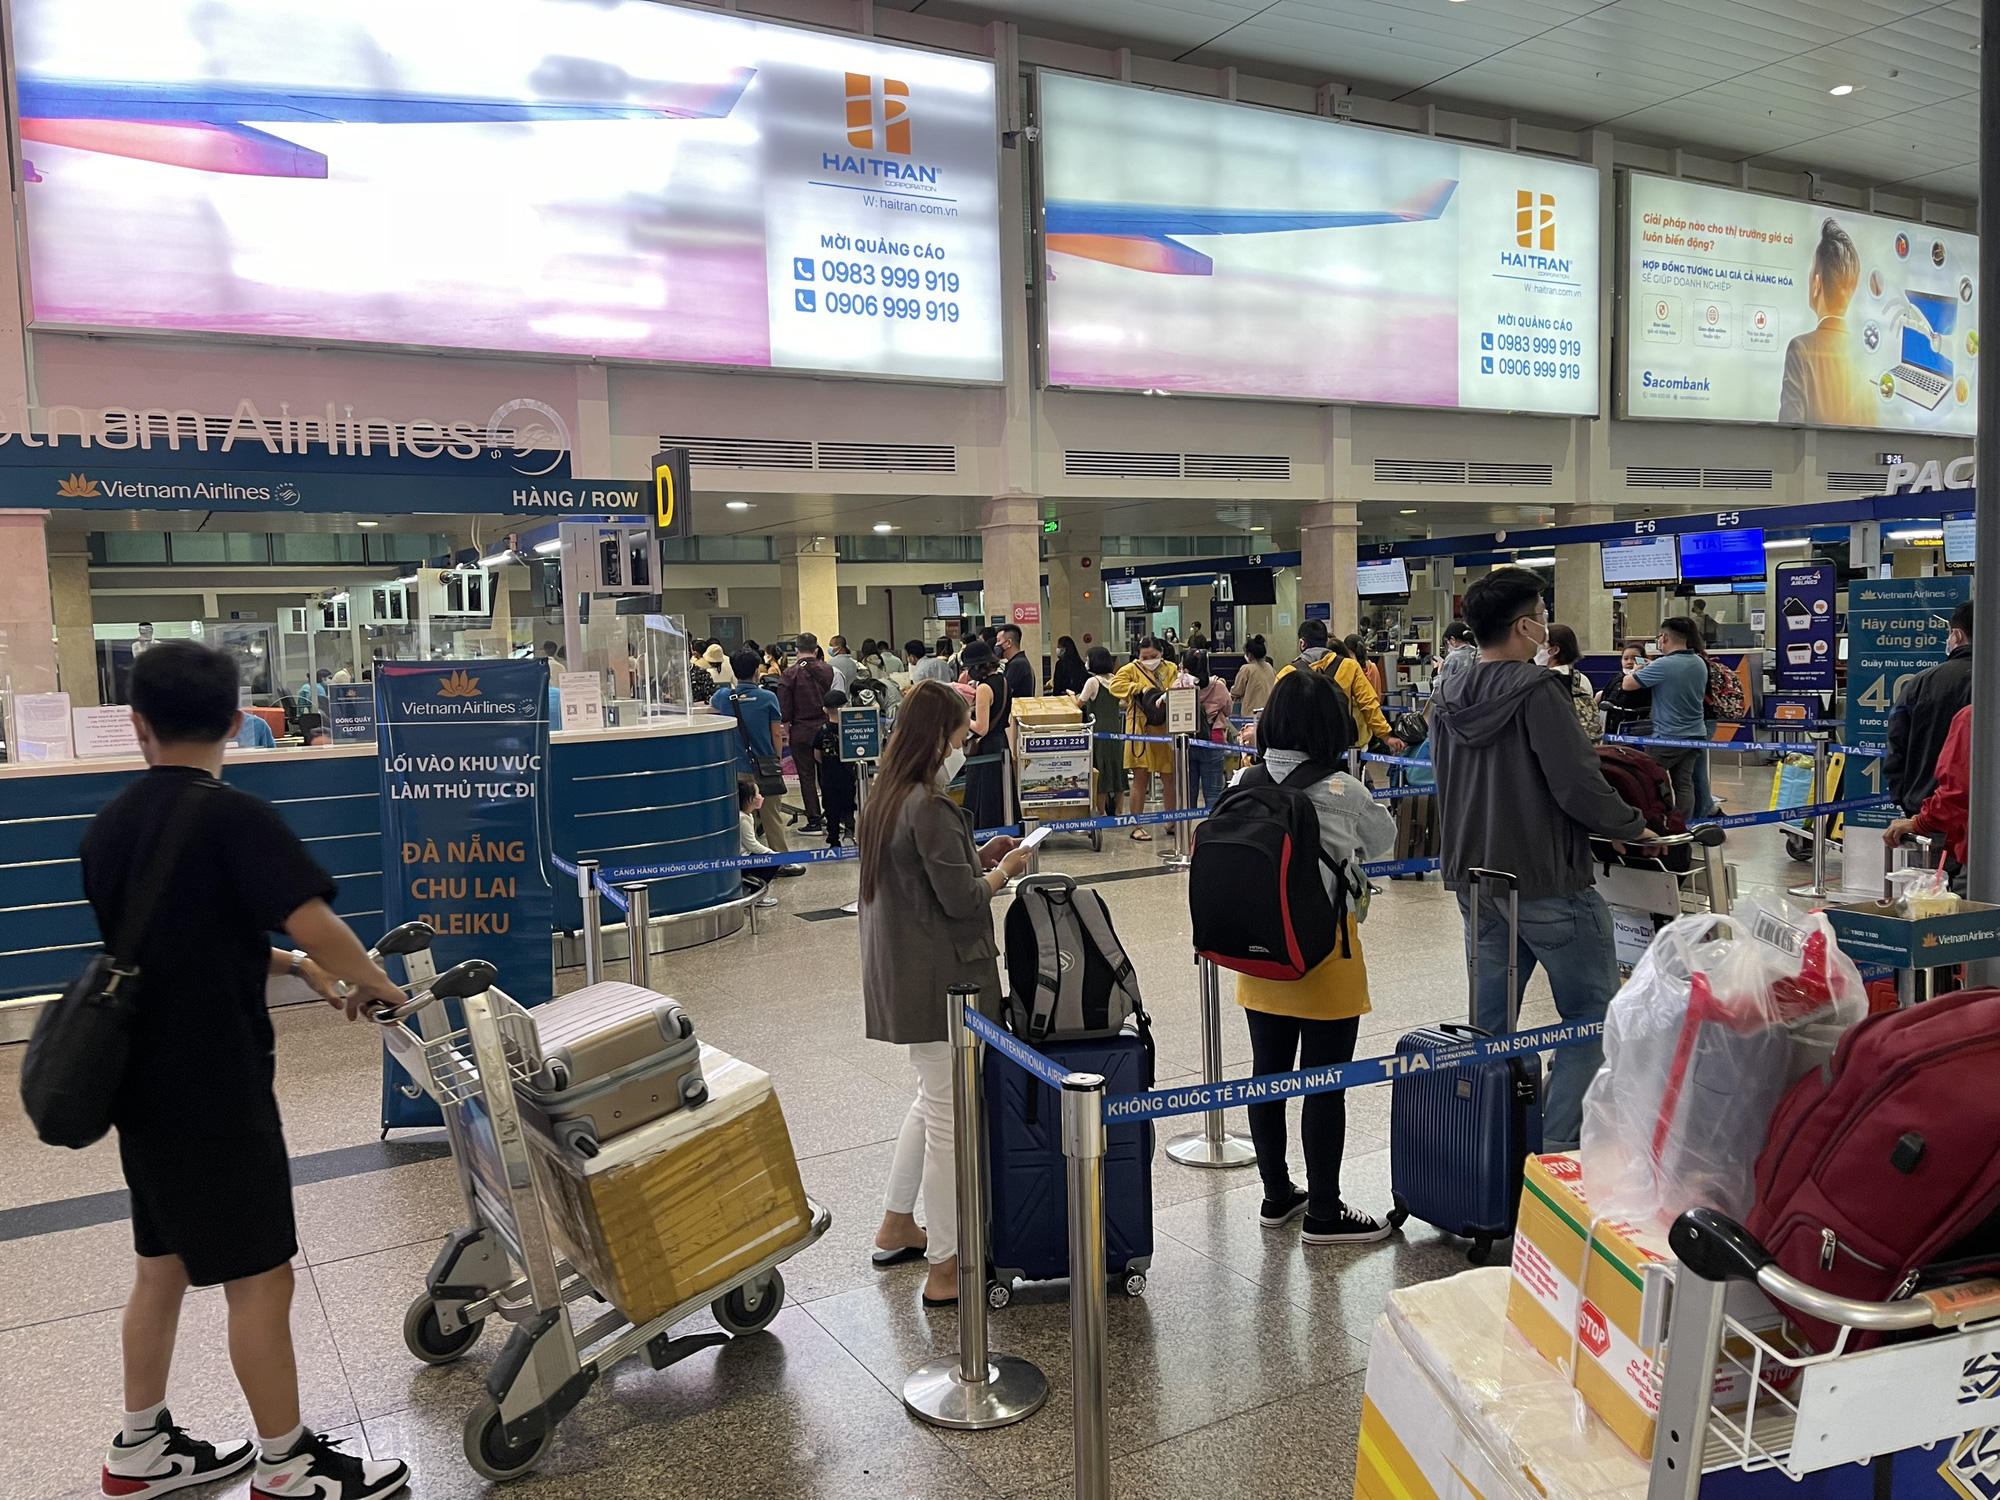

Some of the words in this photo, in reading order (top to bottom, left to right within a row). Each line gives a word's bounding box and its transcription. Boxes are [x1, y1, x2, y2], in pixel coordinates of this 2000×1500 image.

[885, 180, 937, 192] CORPORATION
[863, 195, 878, 207] W:
[880, 197, 958, 216] haitran.com.vn
[1643, 213, 1661, 225] Giải
[1663, 216, 1687, 231] pháp
[1689, 220, 1705, 231] nào
[1707, 223, 1723, 234] cho
[1726, 225, 1737, 239] thị
[1739, 227, 1766, 242] trường
[1769, 232, 1782, 244] giá
[1783, 233, 1793, 244] cả
[821, 233, 850, 250] MỜI
[855, 237, 909, 256] QUẢNG
[913, 243, 945, 259] CÁO
[1643, 231, 1663, 243] luôn
[1665, 233, 1684, 246] biến
[1687, 237, 1715, 251] động?
[822, 260, 875, 285] 0983
[881, 266, 920, 289] 999
[925, 270, 959, 293] 919
[1642, 260, 1660, 271] HỢP
[1662, 261, 1685, 274] ĐỒNG
[1687, 265, 1714, 277] TƯƠNG
[1715, 269, 1728, 278] LAI
[1729, 269, 1742, 280] GIÁ
[1744, 271, 1754, 282] CẢ
[1755, 273, 1776, 284] HÀNG
[1778, 274, 1793, 286] HÓA
[1653, 273, 1672, 284] GIÚP
[1674, 277, 1702, 288] DOANH
[1534, 285, 1582, 298] haitran.com.vn
[825, 291, 878, 316] 0906
[883, 297, 920, 319] 999
[925, 300, 959, 323] 919
[1497, 313, 1516, 326] MỜI
[1518, 315, 1551, 330] QUẢNG
[1553, 318, 1573, 332] CÁO
[1497, 334, 1530, 353] 0983
[1533, 337, 1557, 355] 999
[1560, 340, 1581, 357] 919
[1499, 358, 1531, 376] 0906
[1533, 361, 1556, 378] 999
[1559, 363, 1580, 380] 919
[1642, 371, 1710, 391] Sacombank
[0, 398, 208, 451] tnam
[221, 397, 481, 460] Airlines
[1886, 455, 1902, 464] 9:26
[101, 480, 191, 499] Vietnam
[194, 481, 271, 500] Airlines
[513, 486, 573, 507] HÀNG
[579, 491, 586, 507] /
[591, 491, 639, 507] ROW
[655, 464, 674, 527] D
[1634, 520, 1656, 534] E-6
[1716, 512, 1740, 526] E-5
[1378, 543, 1394, 554] E-7
[1249, 555, 1261, 565] E-8
[1125, 567, 1135, 576] E-9
[1877, 591, 1912, 599] Vietnam
[1913, 590, 1945, 598] Airlines
[1861, 618, 1887, 632] Hãy
[1890, 618, 1925, 631] cùng
[1876, 634, 1911, 648] đúng
[1915, 633, 1938, 648] giờ
[1861, 659, 1883, 668] Quầy
[1885, 659, 1899, 667] thủ
[1901, 660, 1915, 668] tục
[402, 702, 461, 715] Vietnam
[463, 701, 516, 715] Airlines
[1053, 738, 1067, 746] 221
[1842, 746, 1861, 754] TIA
[385, 752, 413, 772] LỐI
[416, 754, 455, 772] VÀO
[459, 756, 498, 771] KHU
[501, 755, 541, 775] VỰC
[391, 782, 428, 800] LÀM
[433, 779, 472, 799] THỦ
[475, 783, 512, 802] TỤC
[515, 782, 535, 798] ĐI
[1114, 816, 1137, 826] TIA
[401, 838, 440, 864] ĐÀ
[449, 833, 525, 863] NẴNG
[613, 868, 635, 877] CẢNG
[637, 866, 658, 875] HÀNG
[659, 864, 686, 873] KHÔNG
[688, 861, 709, 871] QUỐC
[710, 859, 720, 868] TẾ
[721, 859, 736, 867] TÂN
[737, 858, 752, 866] SƠN
[753, 856, 772, 865] NHẤT
[810, 849, 837, 860] TIA
[411, 878, 467, 899] CHU
[475, 877, 516, 898] LAI
[1938, 934, 1969, 945] Vietnam
[1969, 931, 1994, 941] Airlines
[984, 1024, 999, 1043] NHAT
[999, 1034, 1047, 1076] INTERNATIONAL
[1435, 1046, 1447, 1054] TAN
[1447, 1044, 1459, 1052] SON
[1435, 1049, 1478, 1062] INTERNATIONAL
[1107, 1094, 1163, 1116] KHÔNG
[1167, 1086, 1212, 1109] QUỐC
[1215, 1082, 1233, 1102] TẾ
[1236, 1080, 1267, 1098] TÂN
[1270, 1076, 1301, 1094] SƠN
[1305, 1069, 1343, 1089] NHẤT
[1379, 1053, 1431, 1077] TIA
[1485, 1039, 1510, 1055] TAN
[1513, 1034, 1539, 1051] SON
[1542, 1027, 1574, 1044] NHAT
[1577, 1021, 1604, 1038] INTE
[1436, 1060, 1460, 1069] AIRPORT
[1544, 1161, 1579, 1175] STOP
[1580, 1306, 1606, 1345] STOP
[1631, 1359, 1641, 1372] Or
[1626, 1366, 1651, 1395] Check
